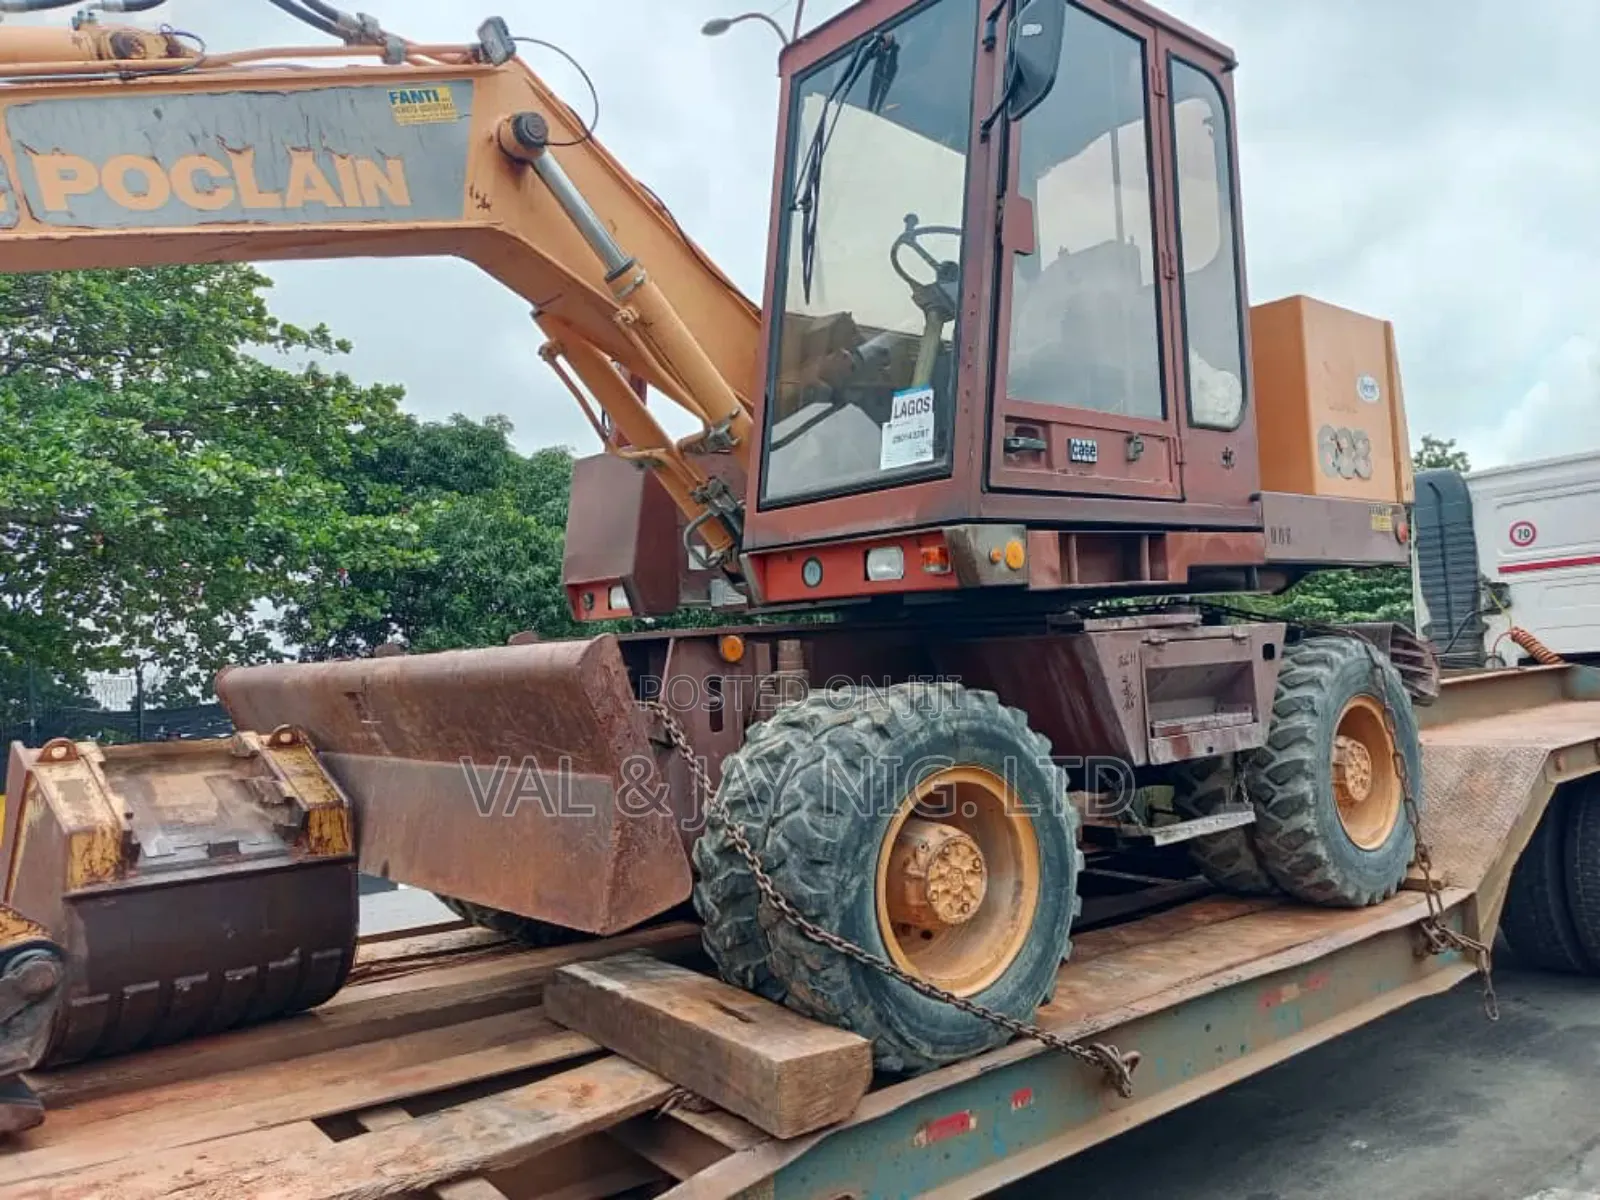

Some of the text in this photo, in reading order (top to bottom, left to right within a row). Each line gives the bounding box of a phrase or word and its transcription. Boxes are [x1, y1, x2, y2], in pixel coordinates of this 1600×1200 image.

[388, 89, 440, 105] FANTI
[31, 146, 412, 211] POCLAIN
[894, 396, 931, 419] LAGOS
[1517, 528, 1530, 540] 10
